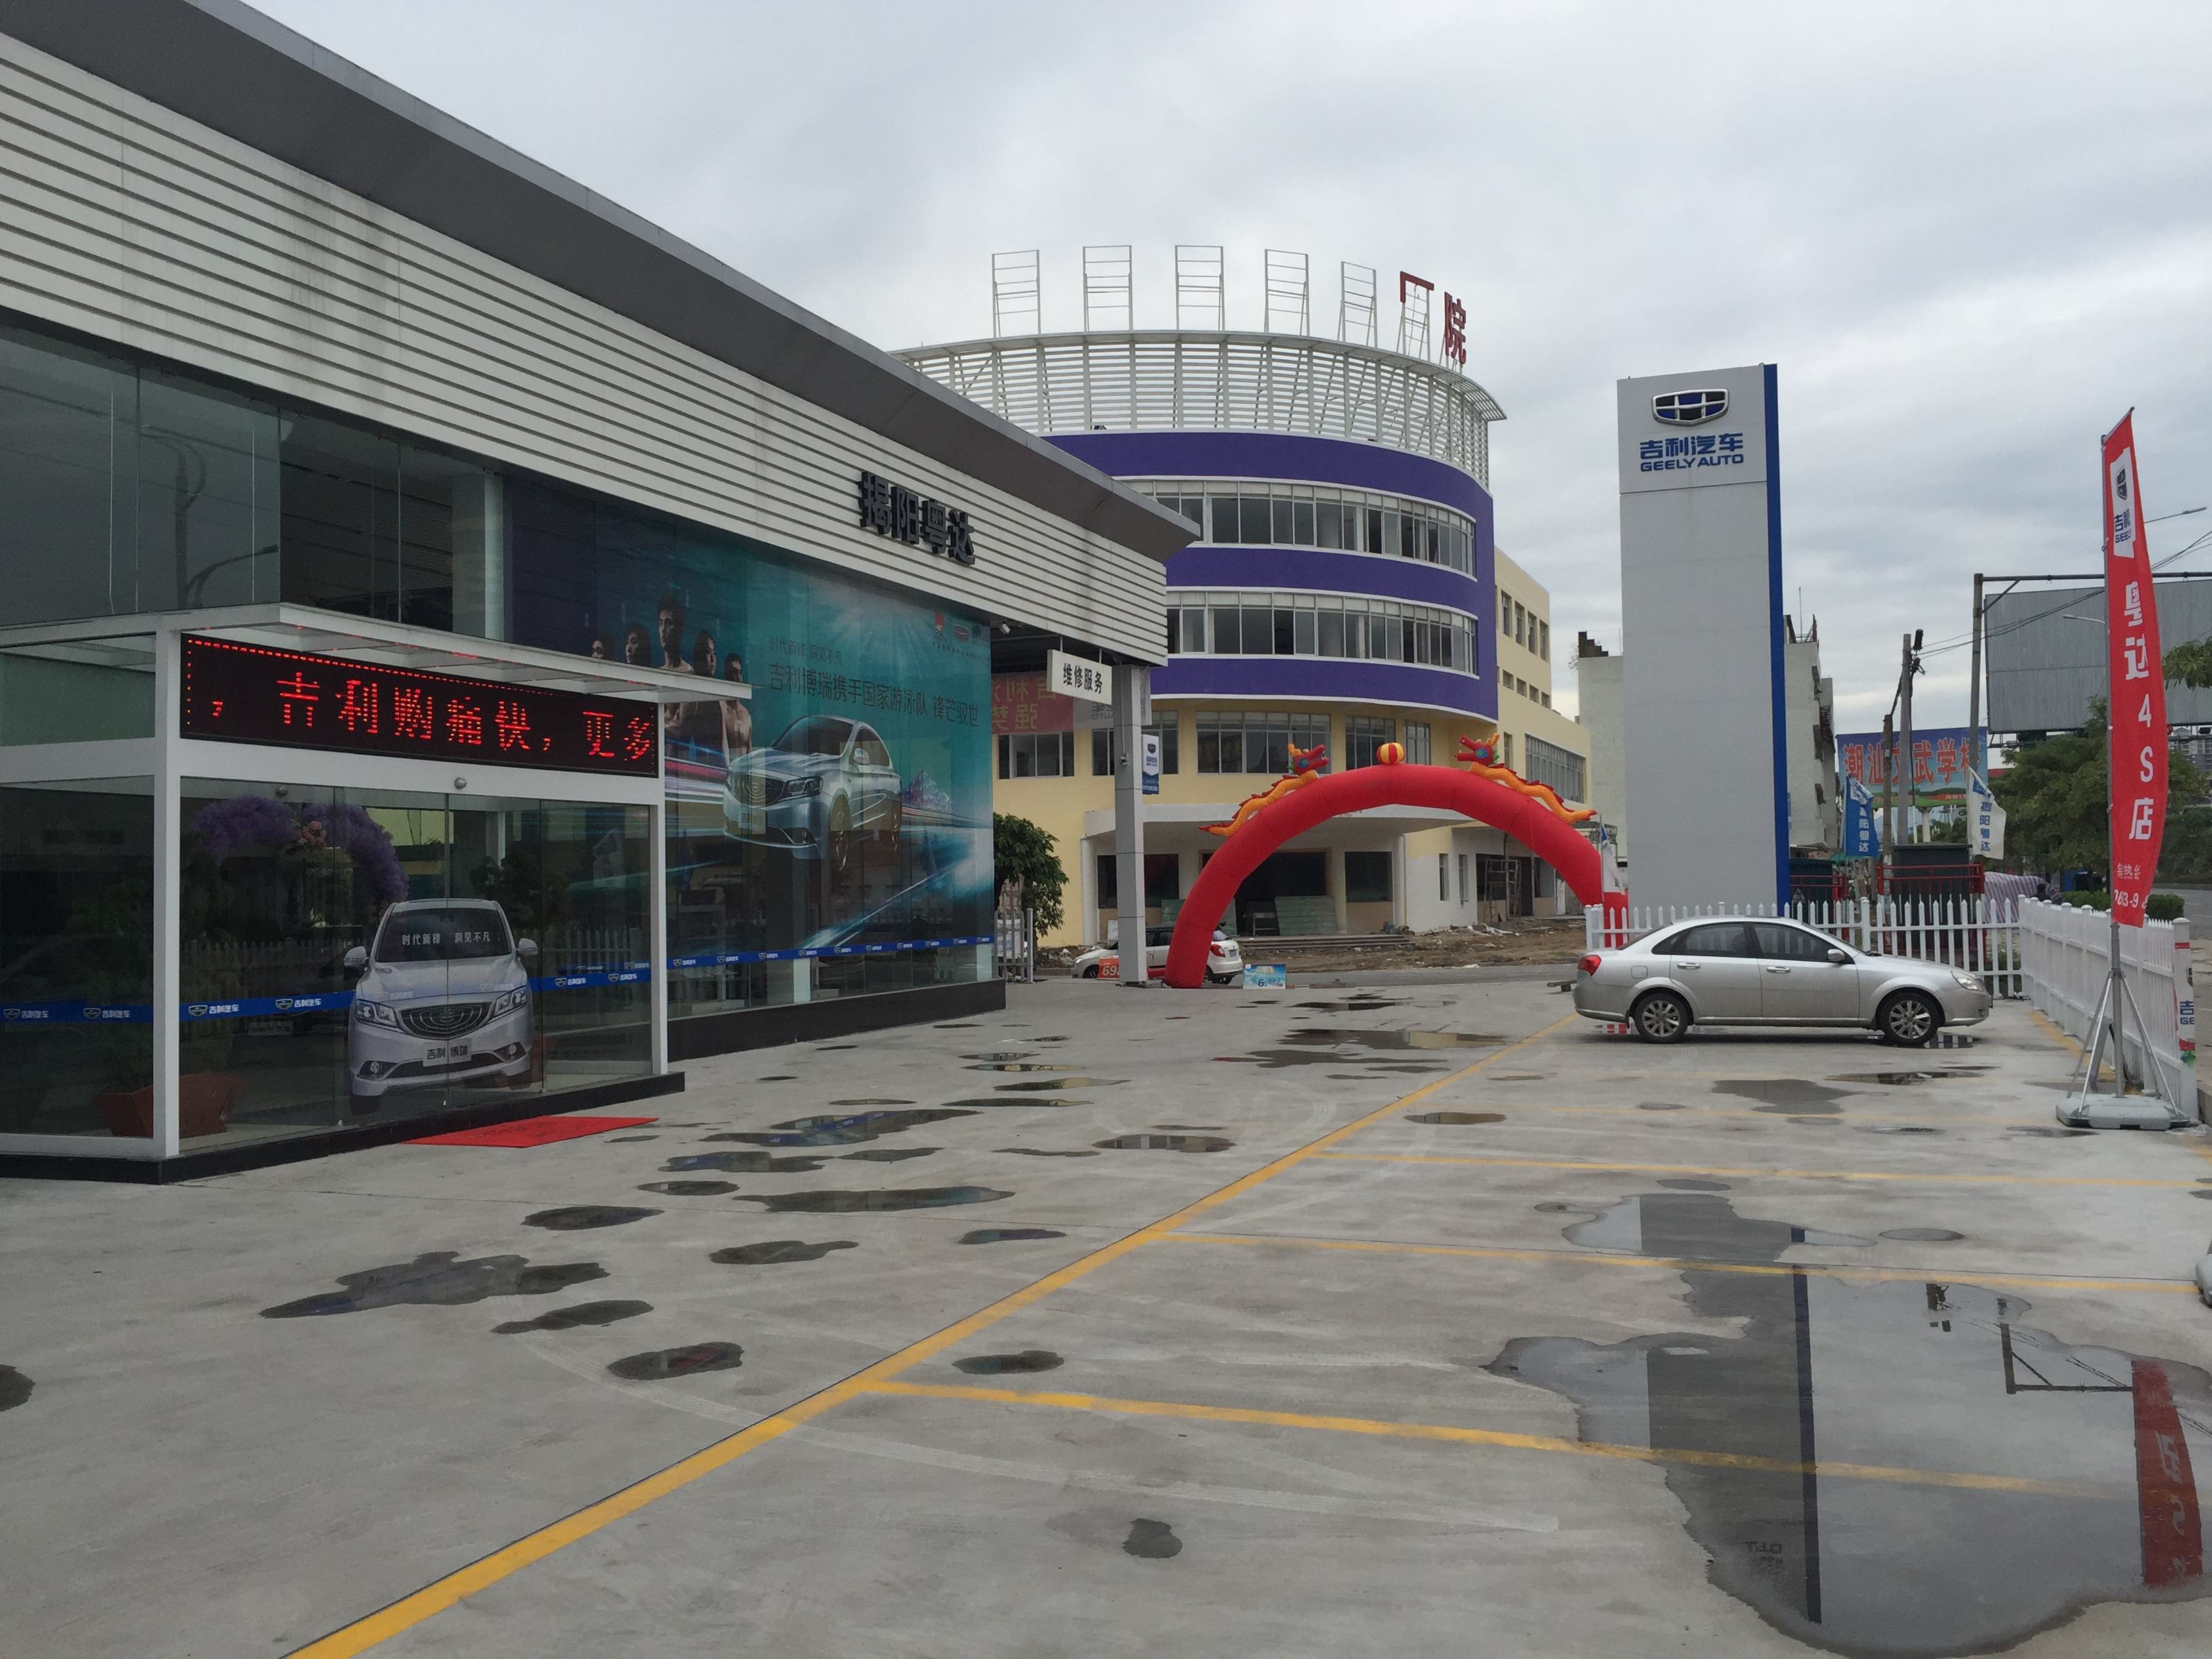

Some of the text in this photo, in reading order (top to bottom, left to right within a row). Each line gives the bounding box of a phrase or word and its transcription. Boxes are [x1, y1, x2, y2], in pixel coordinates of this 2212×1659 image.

[1640, 433, 1744, 459] 吉利汽车
[1641, 453, 1744, 472] GEELY AUTO
[858, 471, 976, 565] 揭阳粤达
[770, 661, 928, 717] 吉利博瑞携手国家游泳队
[1063, 662, 1103, 695] 维修服务
[427, 1048, 446, 1061] 吉利
